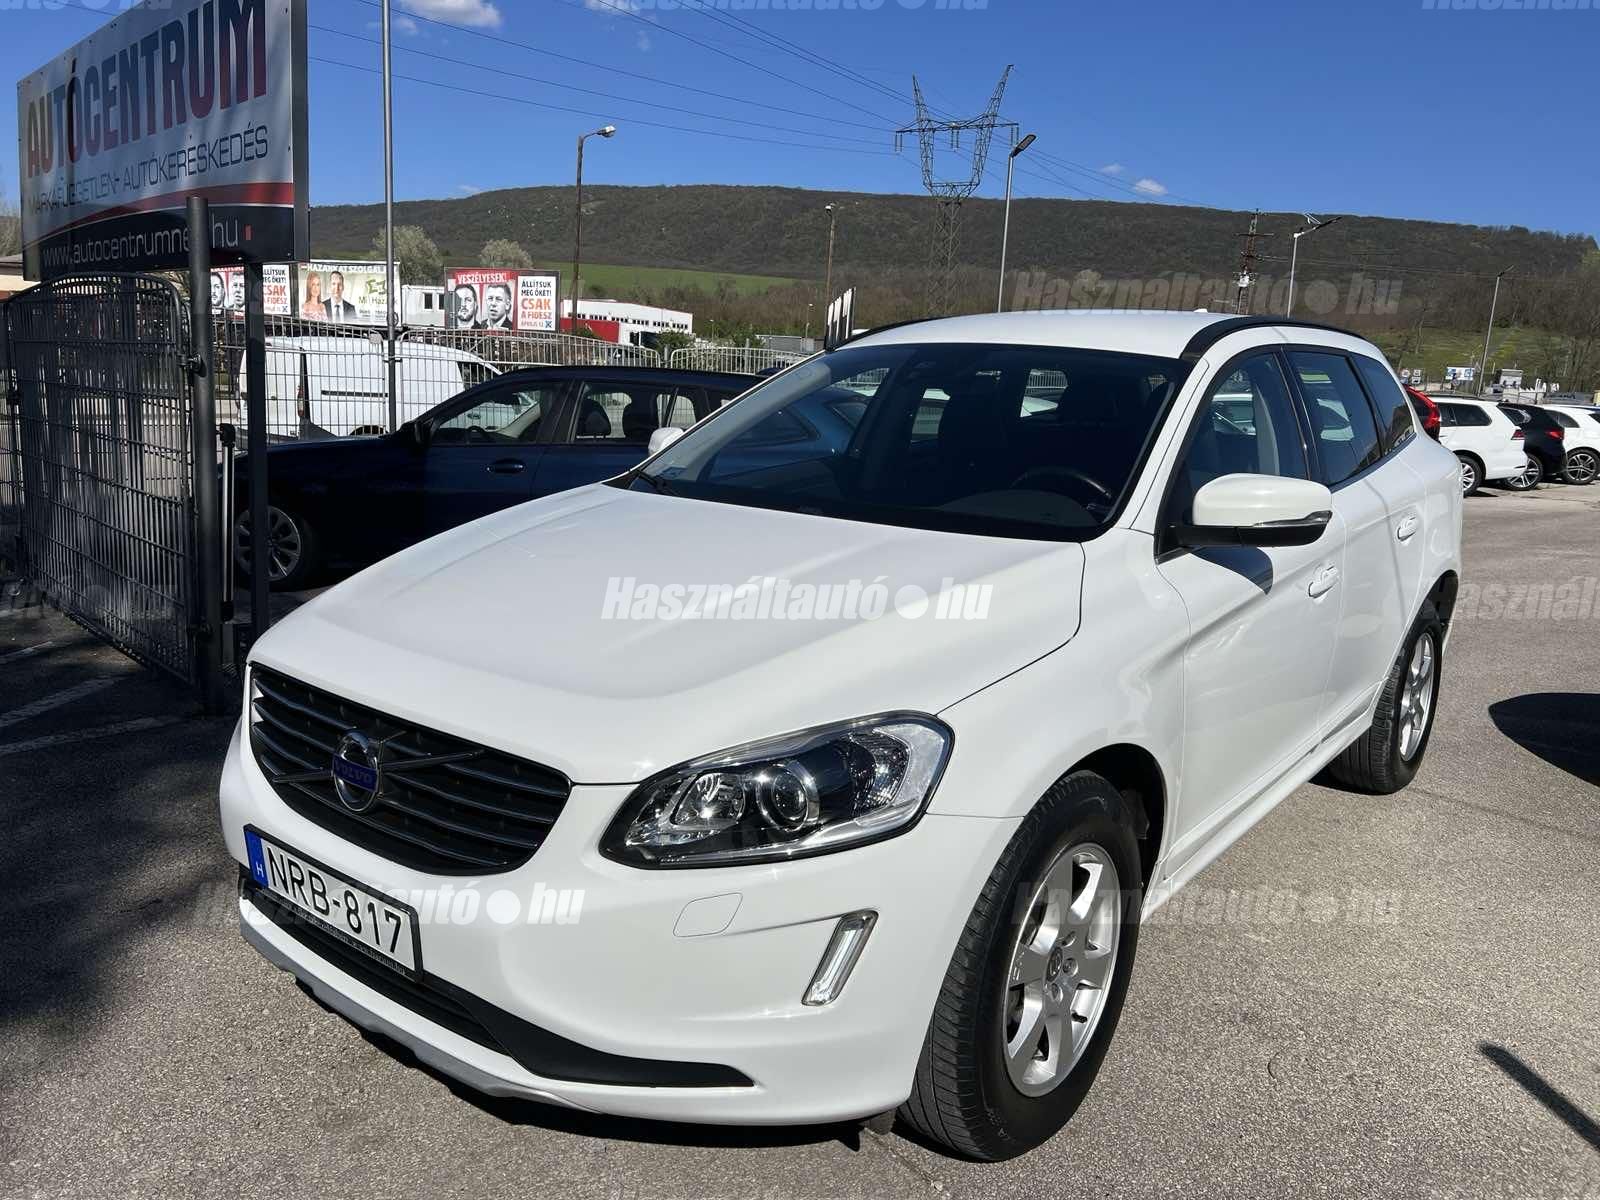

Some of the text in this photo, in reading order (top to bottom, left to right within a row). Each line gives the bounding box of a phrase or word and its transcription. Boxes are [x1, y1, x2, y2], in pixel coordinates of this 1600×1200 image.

[27, 0, 267, 178] AUTÓCENTRUM
[457, 272, 507, 284] VESZÉLYESEK!
[521, 279, 552, 289] ÁLLÍTSUK
[521, 289, 534, 297] MEG
[521, 297, 552, 310] CSAK
[521, 310, 553, 320] A FIDESZ
[256, 861, 266, 880] H
[266, 846, 402, 954] NRB-817
